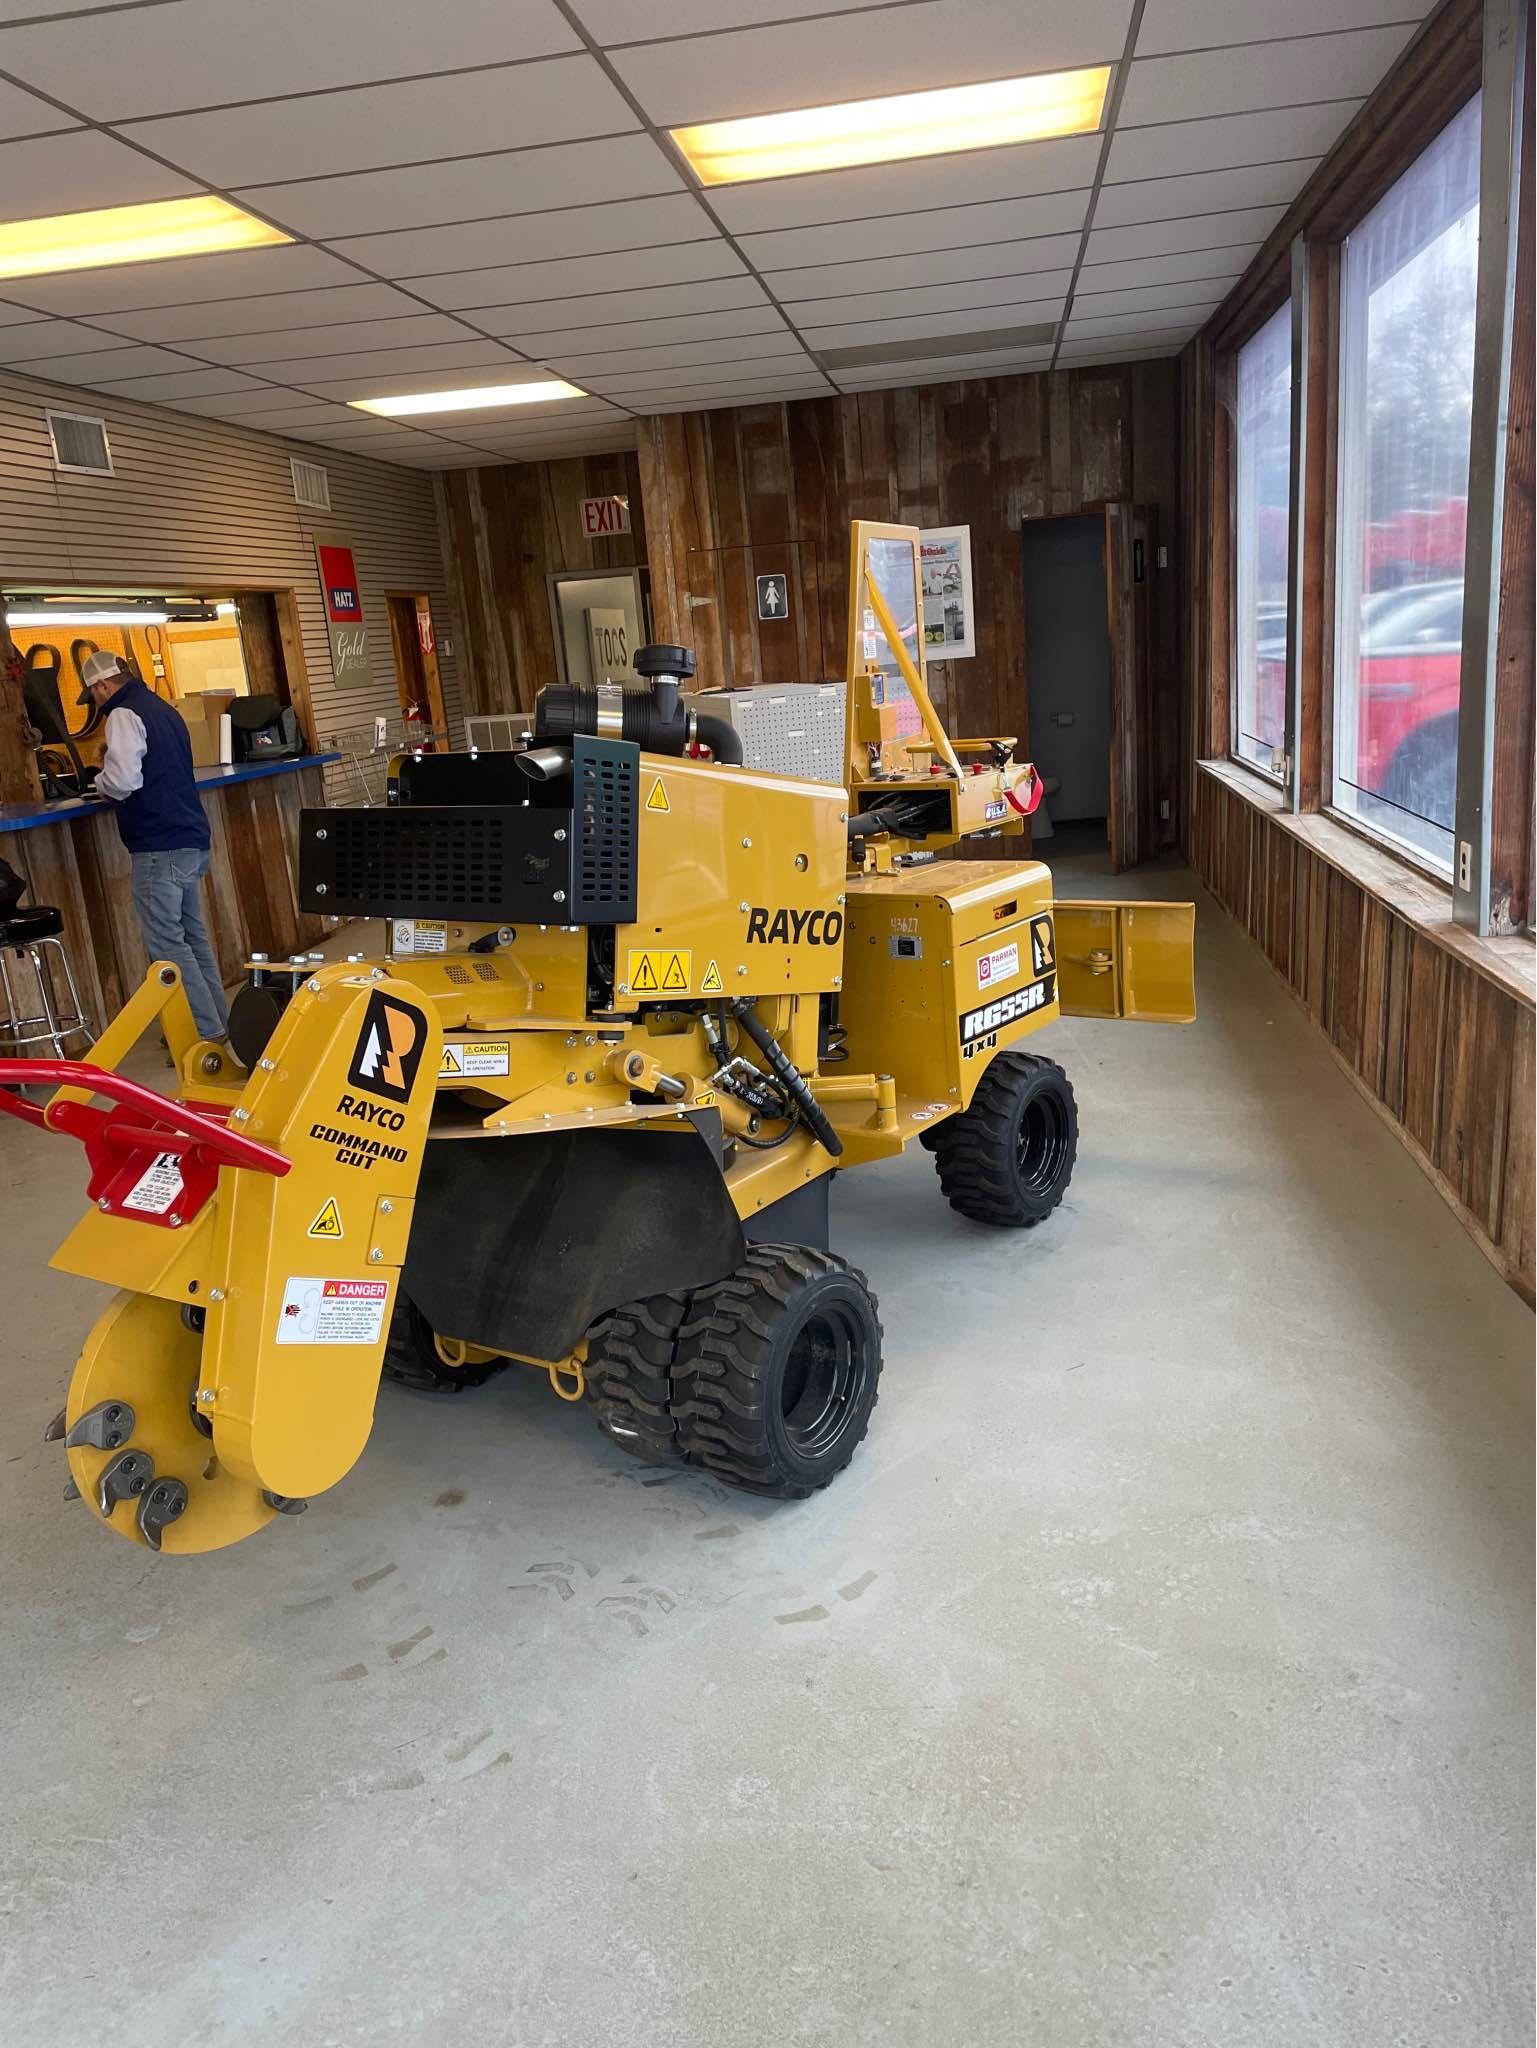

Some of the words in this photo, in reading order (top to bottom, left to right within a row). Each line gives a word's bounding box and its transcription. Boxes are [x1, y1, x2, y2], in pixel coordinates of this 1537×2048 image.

[584, 500, 624, 533] EXIT
[334, 591, 354, 608] HATZ
[336, 631, 366, 676] Gold
[746, 907, 843, 946] RAYCO
[991, 947, 1017, 965] PARMAN
[474, 1045, 508, 1053] CAUTION
[336, 1094, 405, 1131] RAYCO
[309, 1124, 408, 1163] COMMAND
[336, 1149, 377, 1170] CUT
[339, 1284, 384, 1296] DANGER
